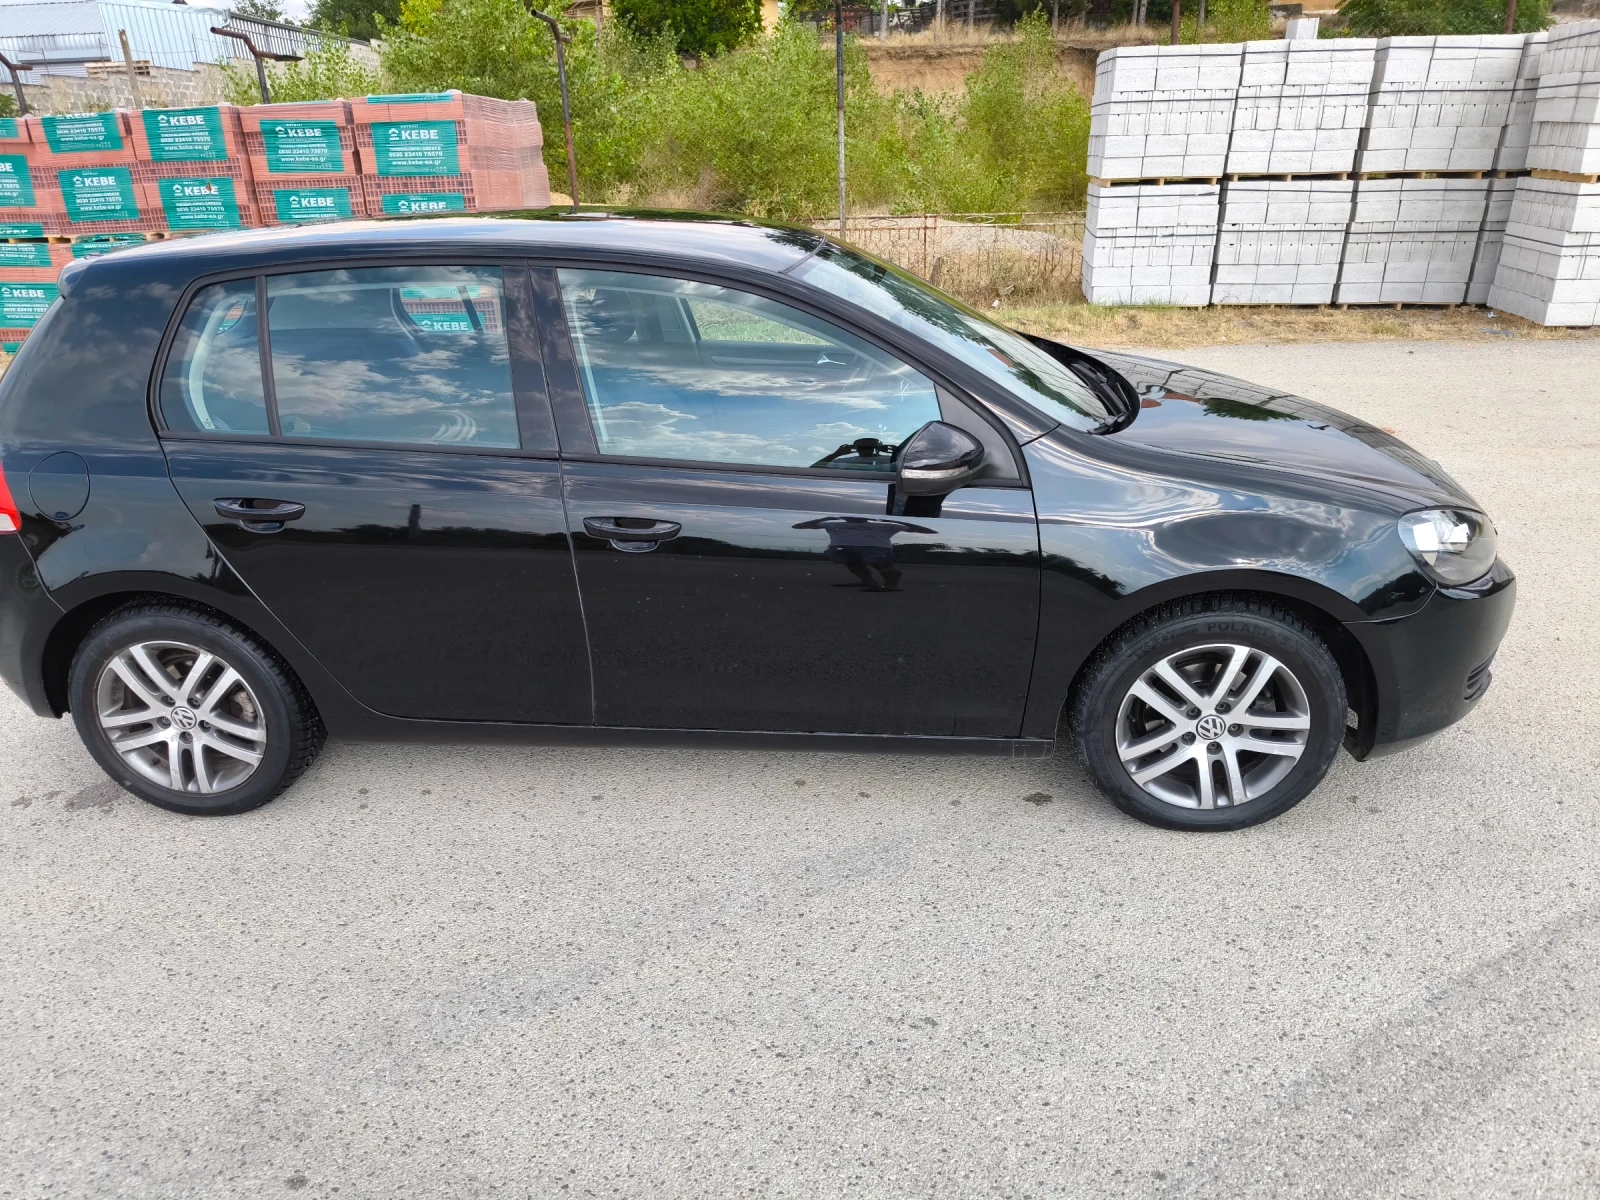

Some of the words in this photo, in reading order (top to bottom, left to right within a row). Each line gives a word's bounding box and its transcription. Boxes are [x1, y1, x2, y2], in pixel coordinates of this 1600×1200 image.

[169, 115, 205, 126] KEBE
[287, 128, 322, 137] KEBE
[401, 129, 439, 140] KEBE
[84, 176, 117, 187] KEBE
[184, 185, 219, 196] KEBE
[301, 197, 335, 207] KEBE
[12, 289, 46, 298] KEBE
[433, 321, 469, 331] KEBE
